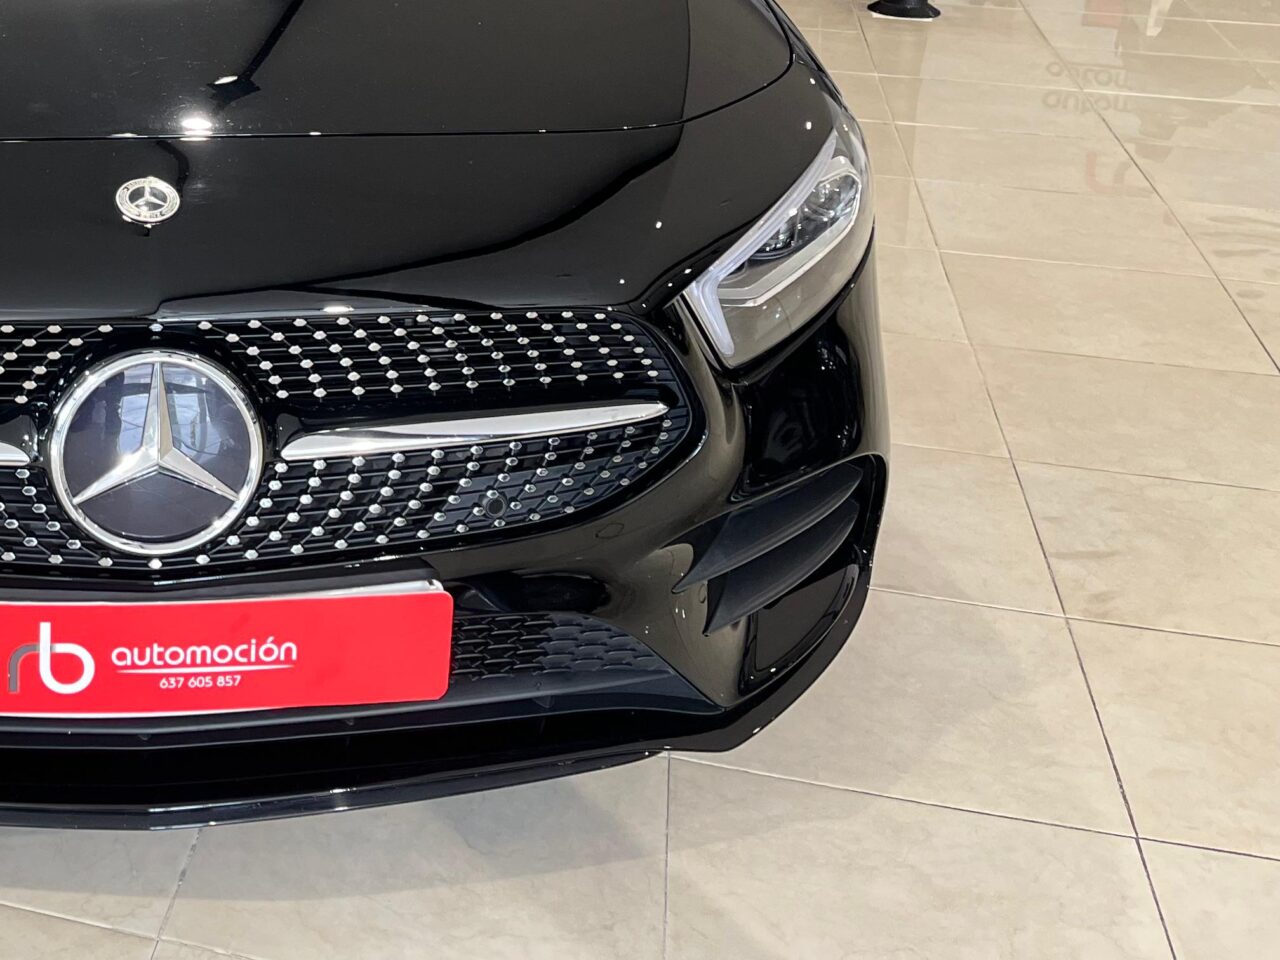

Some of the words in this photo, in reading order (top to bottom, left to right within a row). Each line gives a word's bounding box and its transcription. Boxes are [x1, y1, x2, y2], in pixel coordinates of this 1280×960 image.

[7, 621, 96, 695] rb
[111, 636, 297, 666] automoción
[159, 677, 184, 689] 637
[187, 676, 213, 688] 605
[216, 675, 241, 687] 857
